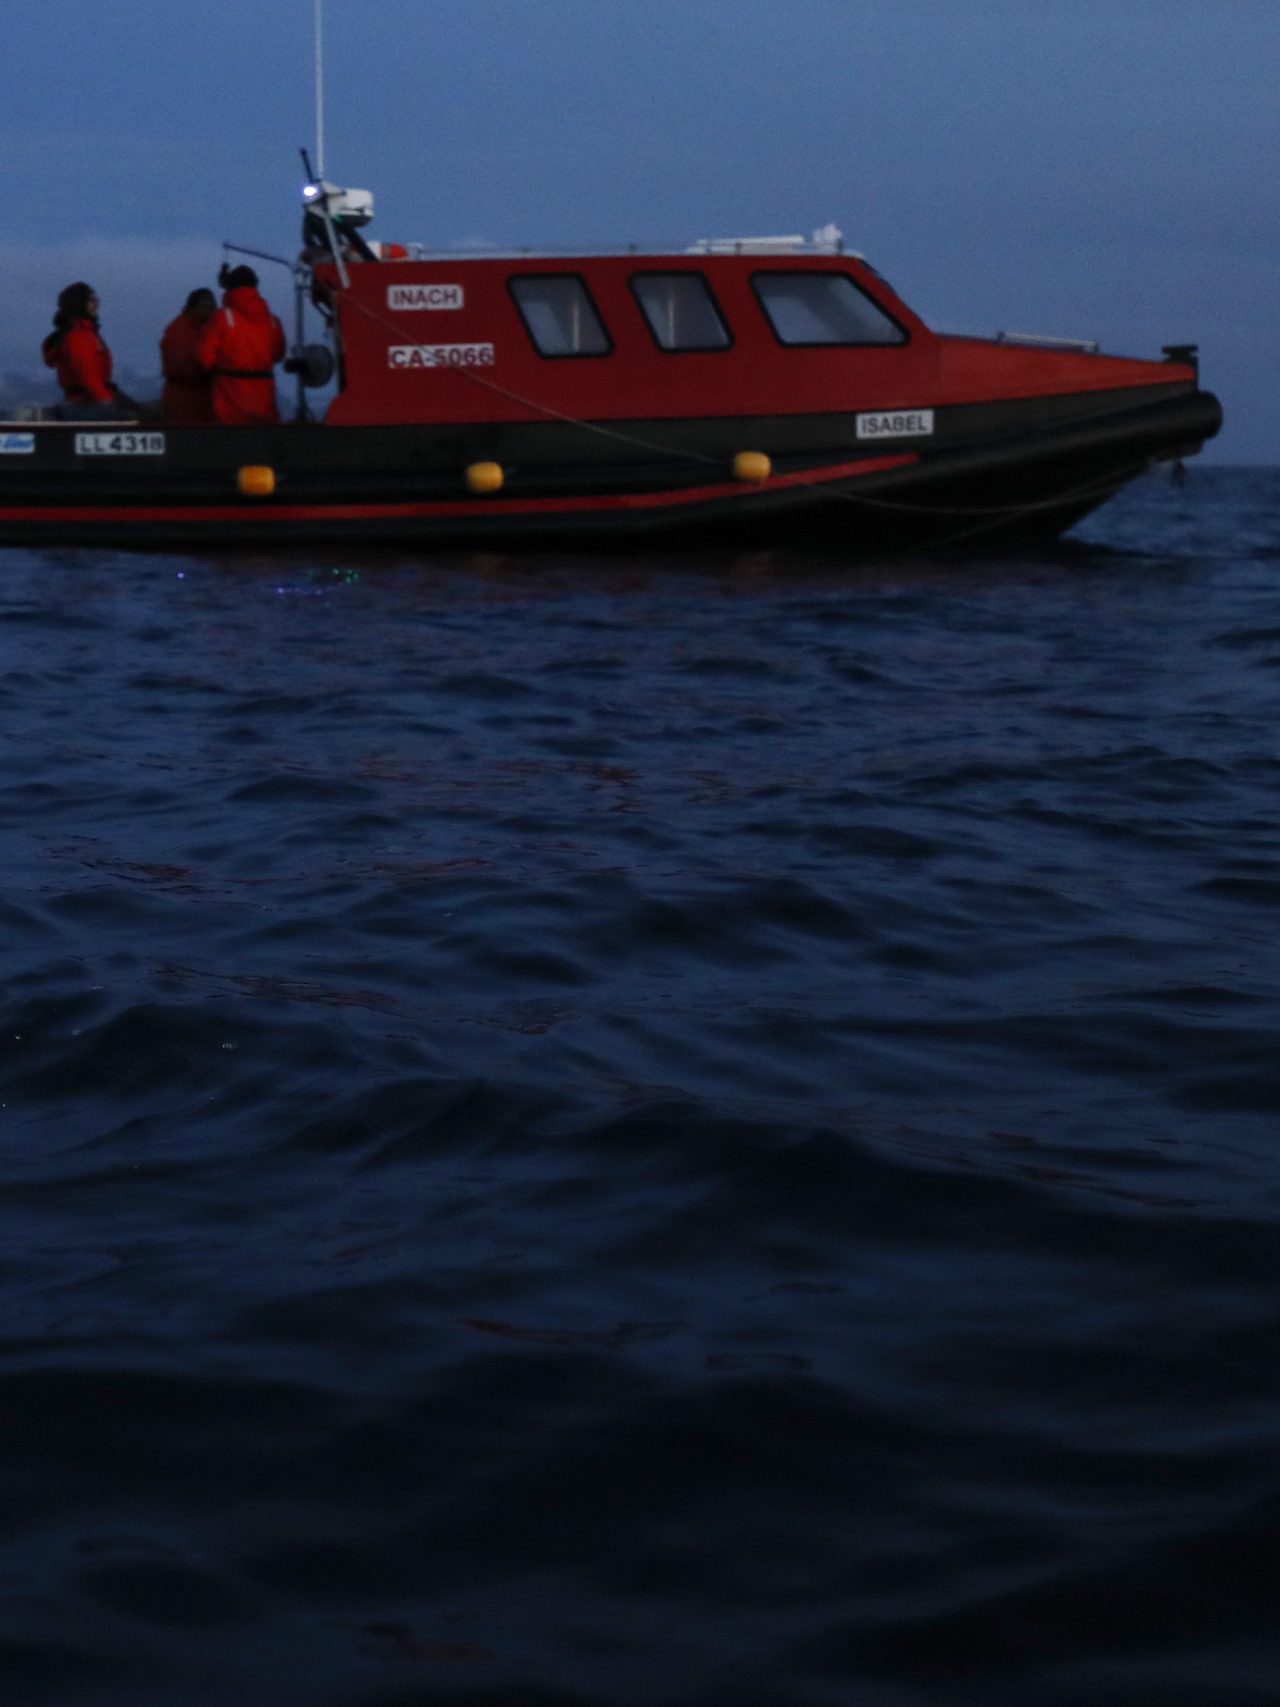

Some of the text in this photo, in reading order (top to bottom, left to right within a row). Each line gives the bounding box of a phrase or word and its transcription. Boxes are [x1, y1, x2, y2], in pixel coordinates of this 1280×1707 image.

[392, 288, 458, 305] INACH
[390, 346, 492, 367] CA-5066
[861, 414, 929, 434] ISABEL
